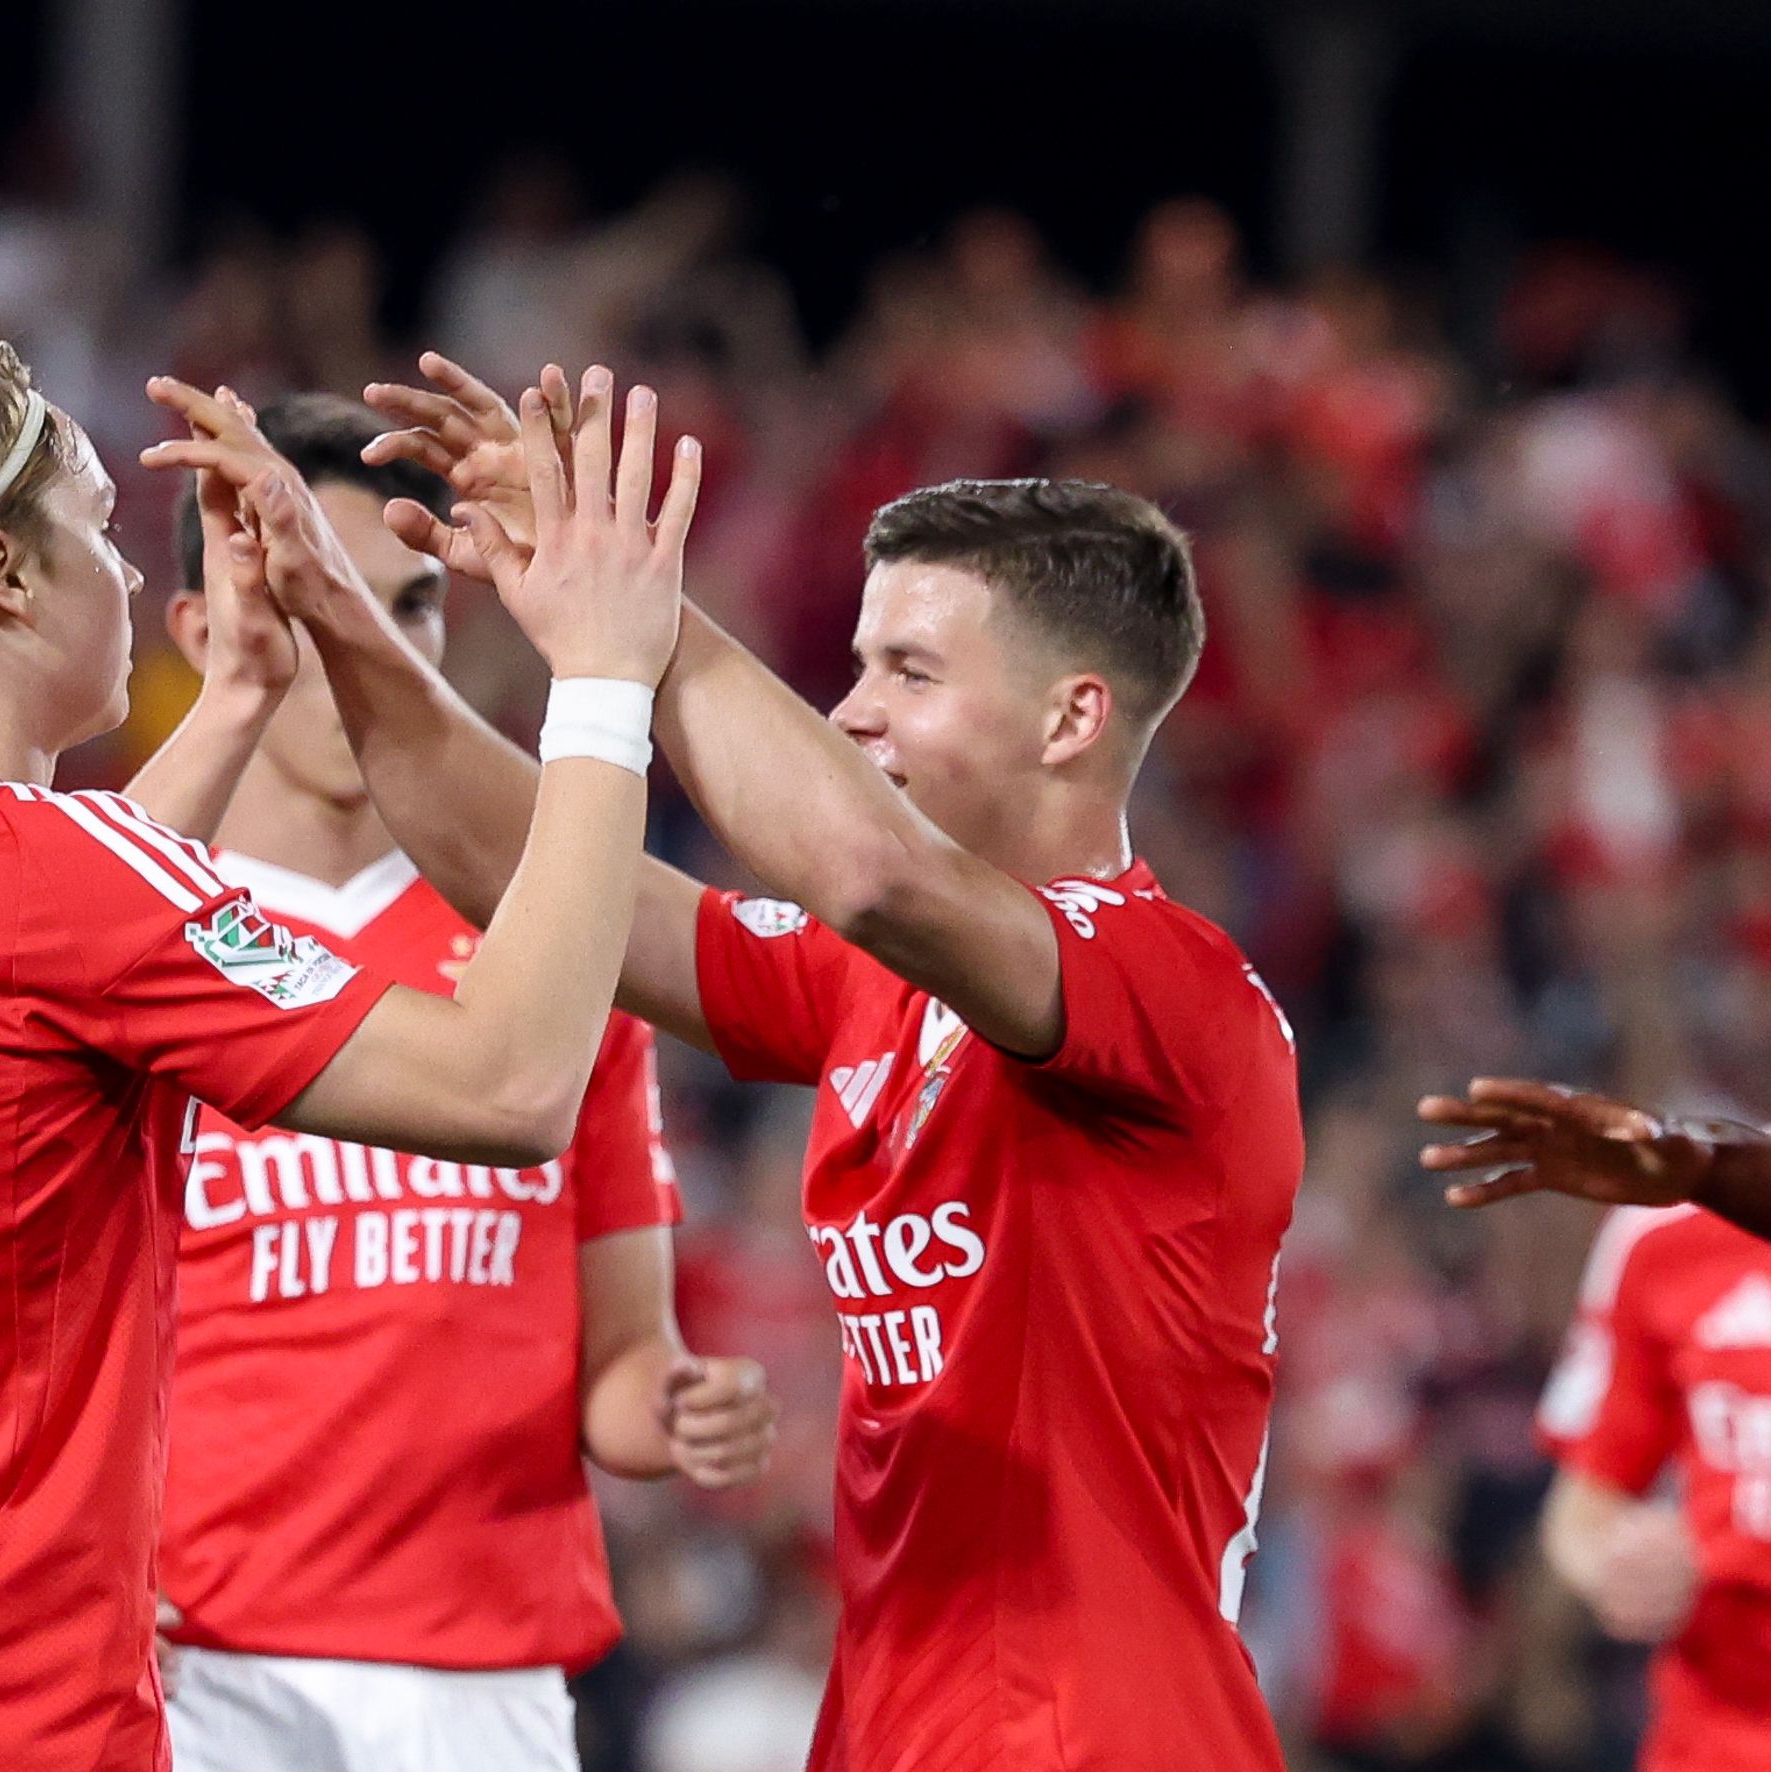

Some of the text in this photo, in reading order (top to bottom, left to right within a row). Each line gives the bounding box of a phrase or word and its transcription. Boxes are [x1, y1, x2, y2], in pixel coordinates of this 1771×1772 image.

[249, 1207, 522, 1303] FLY BETTER
[808, 1202, 986, 1298] ates
